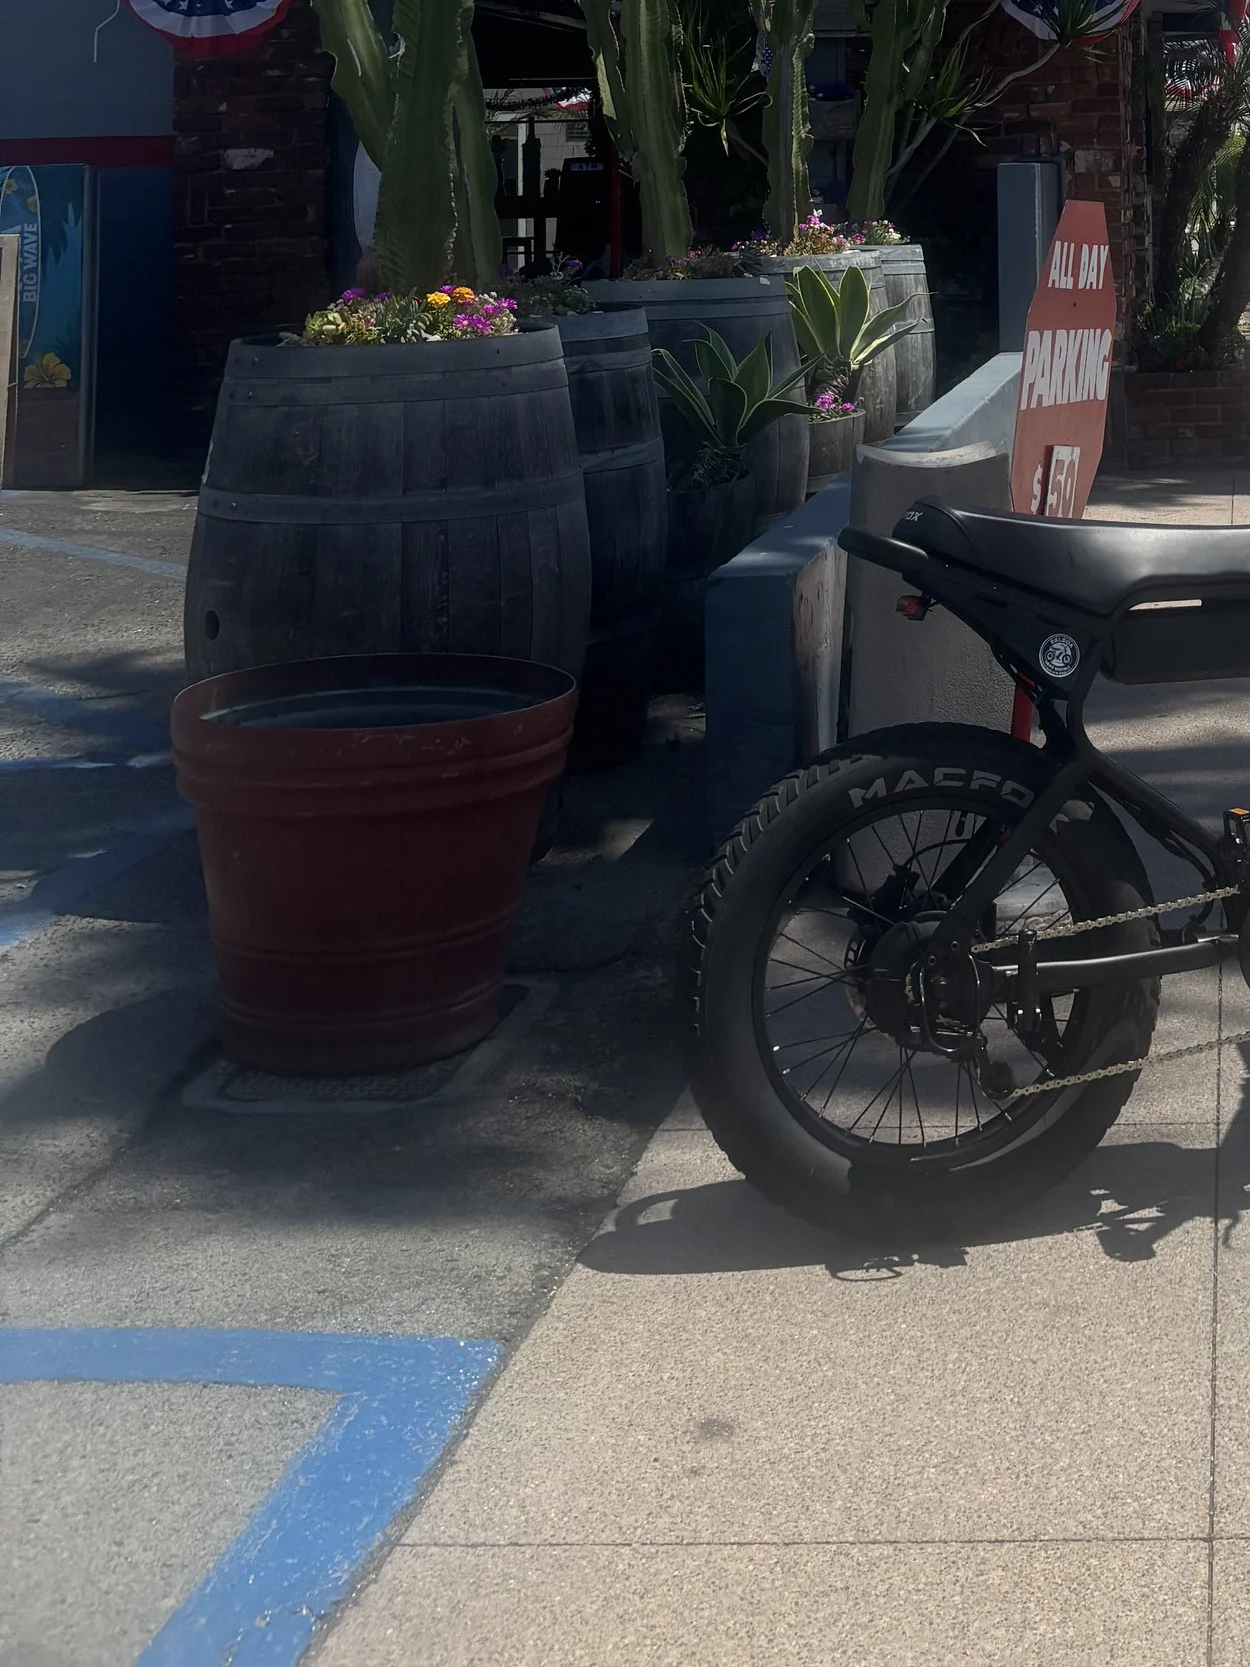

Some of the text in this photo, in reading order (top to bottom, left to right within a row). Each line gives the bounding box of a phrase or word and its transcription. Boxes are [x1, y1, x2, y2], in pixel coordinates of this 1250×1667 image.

[23, 223, 38, 303] BIG WAVE
[1048, 240, 1110, 290] ALL DAY
[1020, 328, 1112, 411] PARKING
[848, 767, 1036, 809] MACFO
